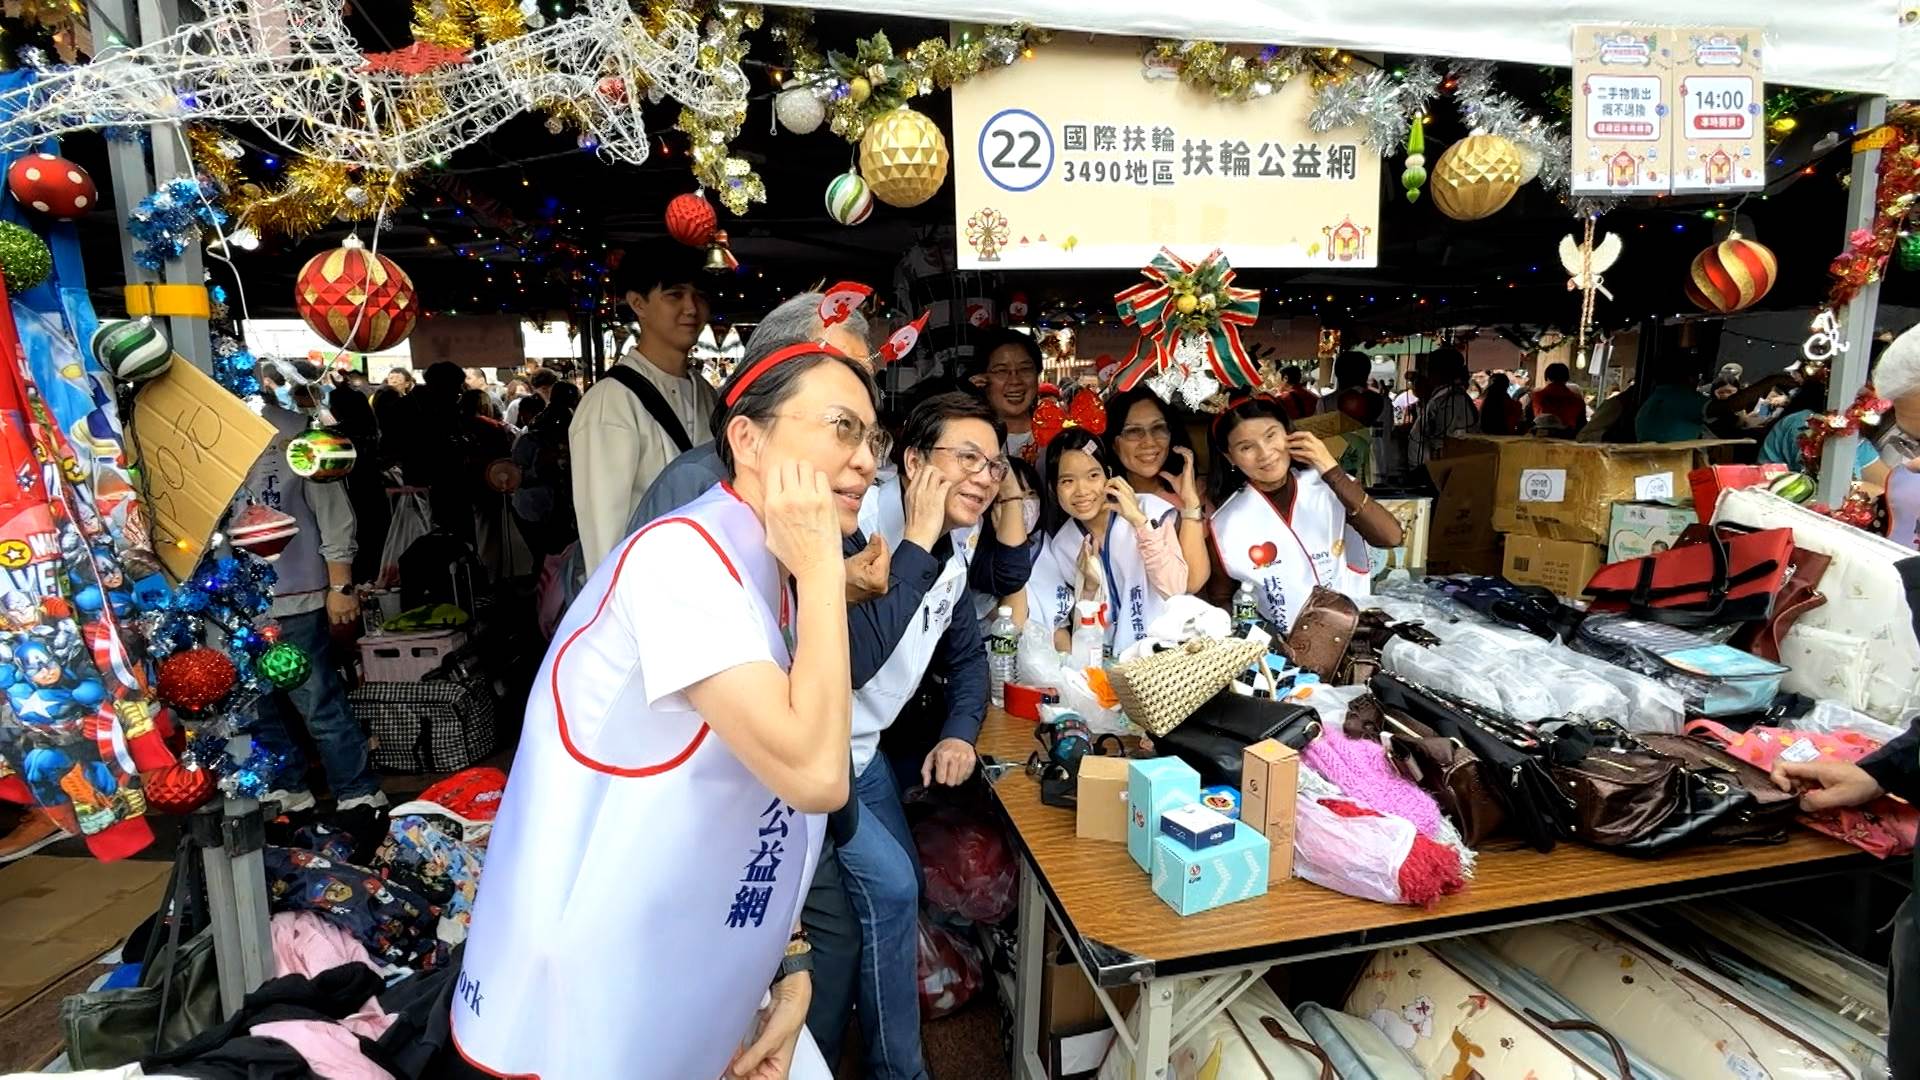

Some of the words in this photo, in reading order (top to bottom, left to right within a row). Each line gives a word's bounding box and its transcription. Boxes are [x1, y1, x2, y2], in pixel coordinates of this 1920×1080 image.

[1597, 87, 1652, 101] 二手物售出
[1696, 90, 1744, 110] 14:00
[991, 129, 1042, 169] 22
[1063, 124, 1175, 152] 國際扶輪
[1063, 158, 1175, 186] 3490地區
[1181, 138, 1357, 181] 扶輪公益網
[725, 797, 796, 929] 公益網
